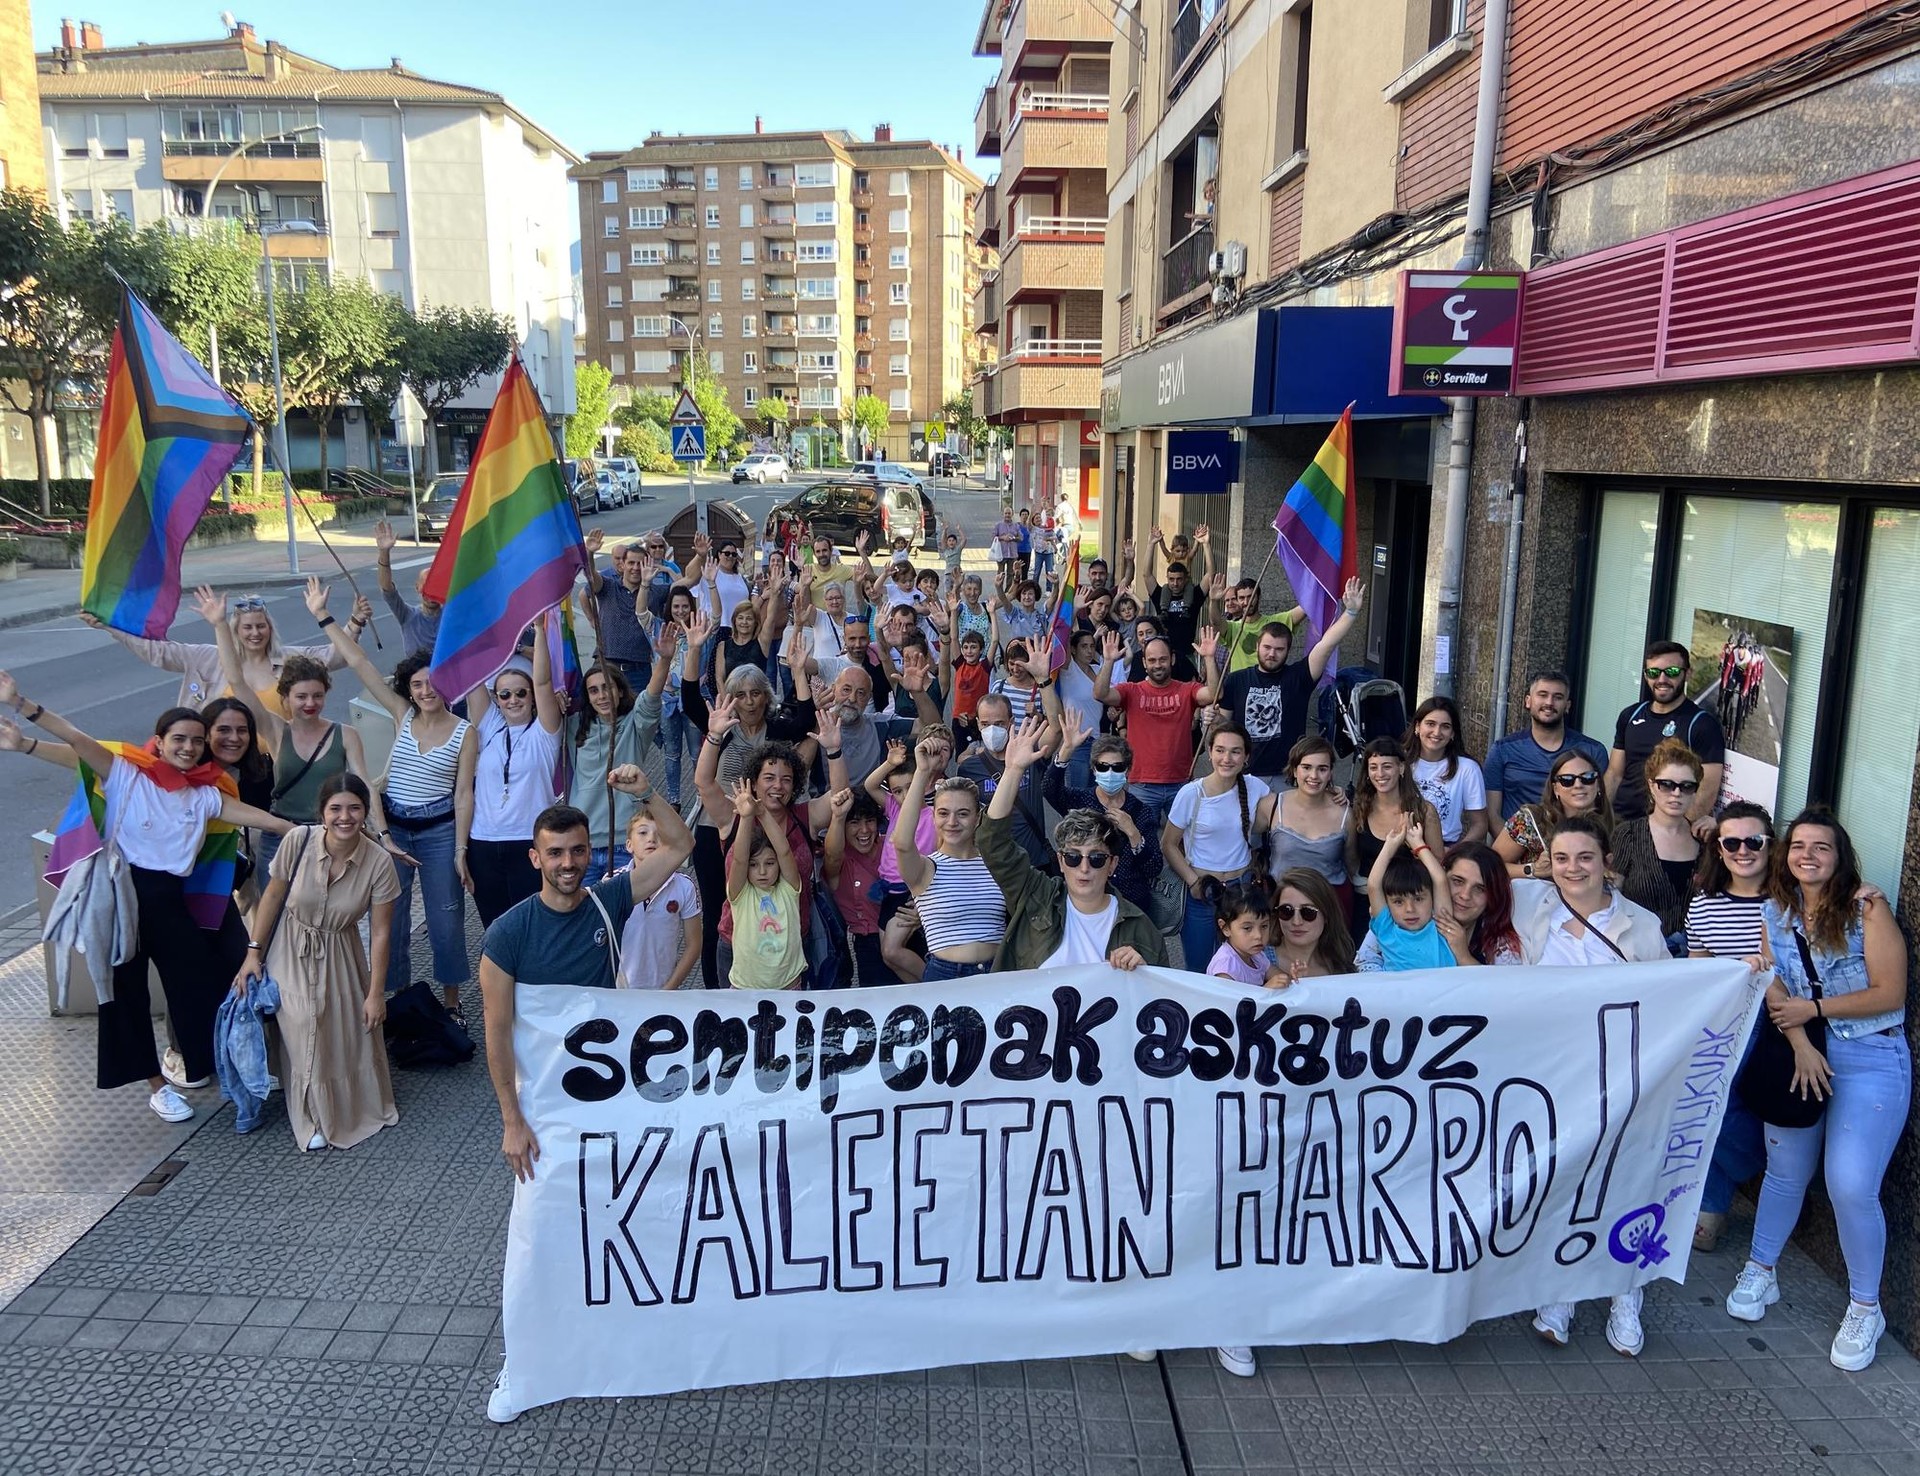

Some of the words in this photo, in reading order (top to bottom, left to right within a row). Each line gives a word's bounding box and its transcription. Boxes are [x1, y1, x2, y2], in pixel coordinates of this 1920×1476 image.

[1157, 353, 1185, 406] BBVA
[1443, 372, 1488, 384] ServiRed
[1172, 454, 1222, 470] BBVA
[1377, 552, 1387, 562] BBV
[561, 985, 1119, 1114] sentipenak
[1133, 996, 1489, 1087] askatuz
[1660, 1012, 1743, 1178] IZPILIKUAK
[579, 1095, 1174, 1307] KALEETAN
